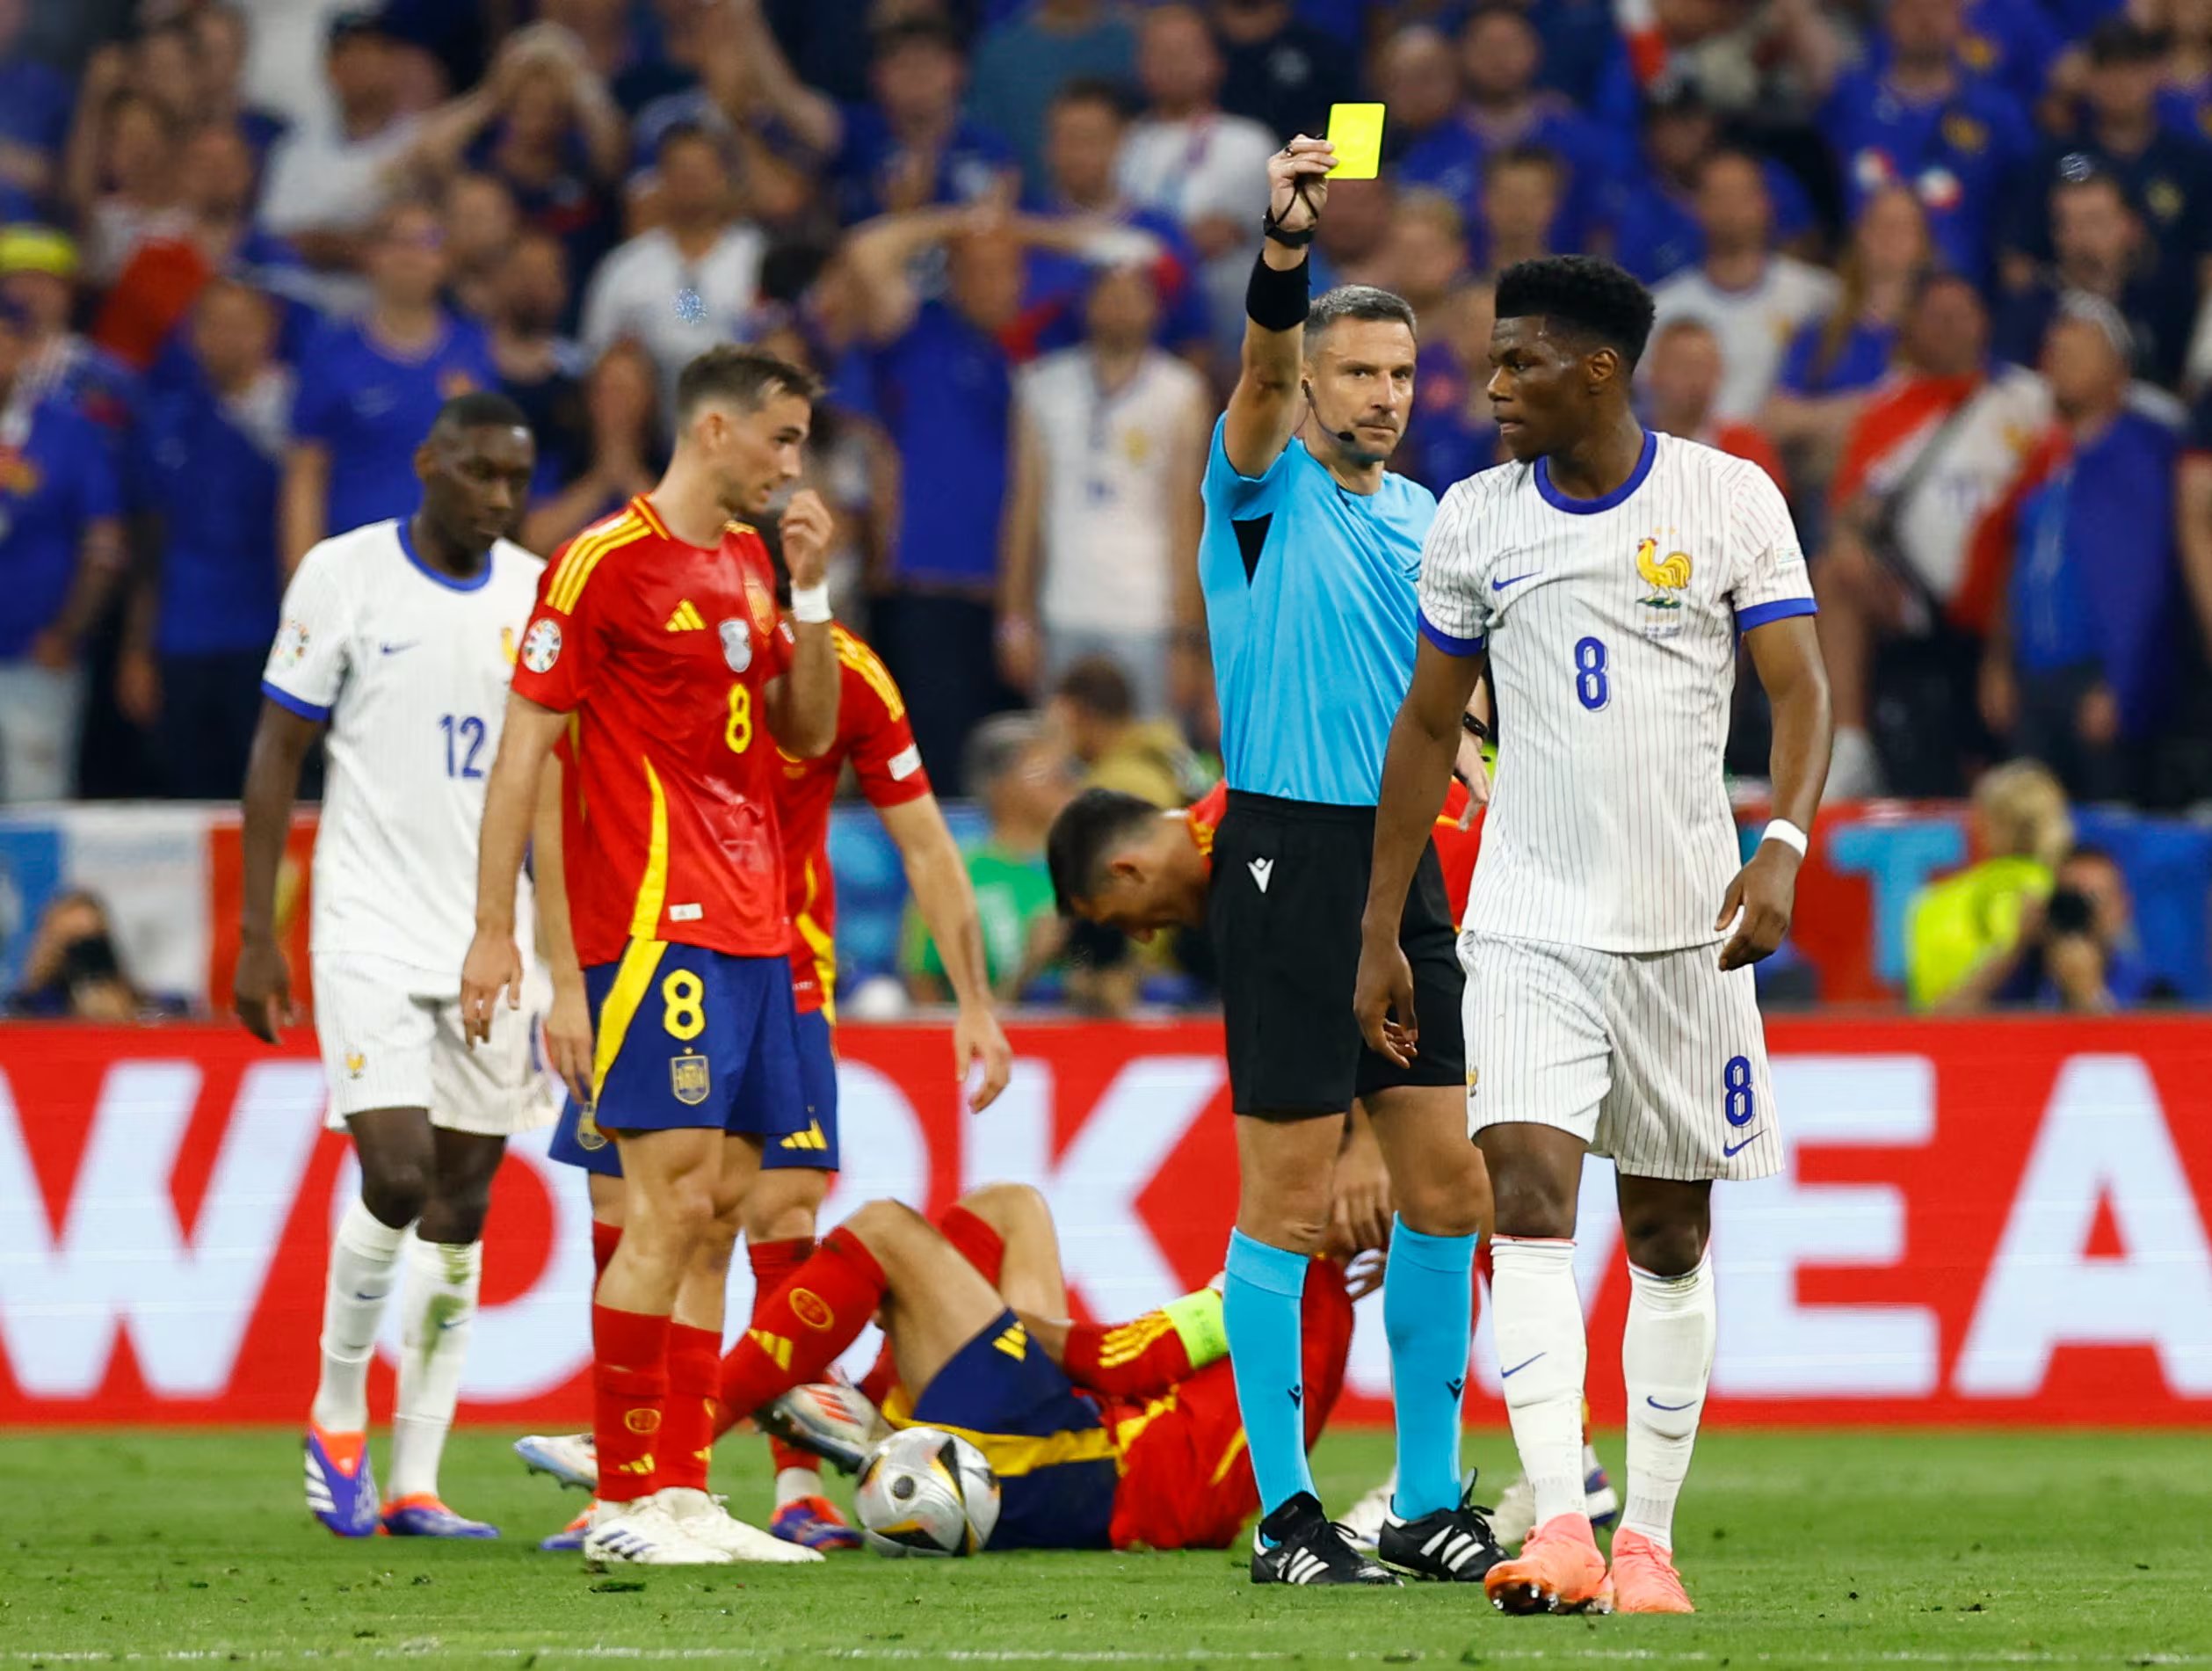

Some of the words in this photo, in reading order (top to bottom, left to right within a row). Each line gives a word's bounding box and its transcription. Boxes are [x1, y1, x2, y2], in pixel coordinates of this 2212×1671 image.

[1574, 636, 1611, 712] 8
[439, 714, 484, 778] 12
[725, 683, 752, 754] 8
[662, 969, 706, 1042] 8
[1724, 1056, 1756, 1129] 8
